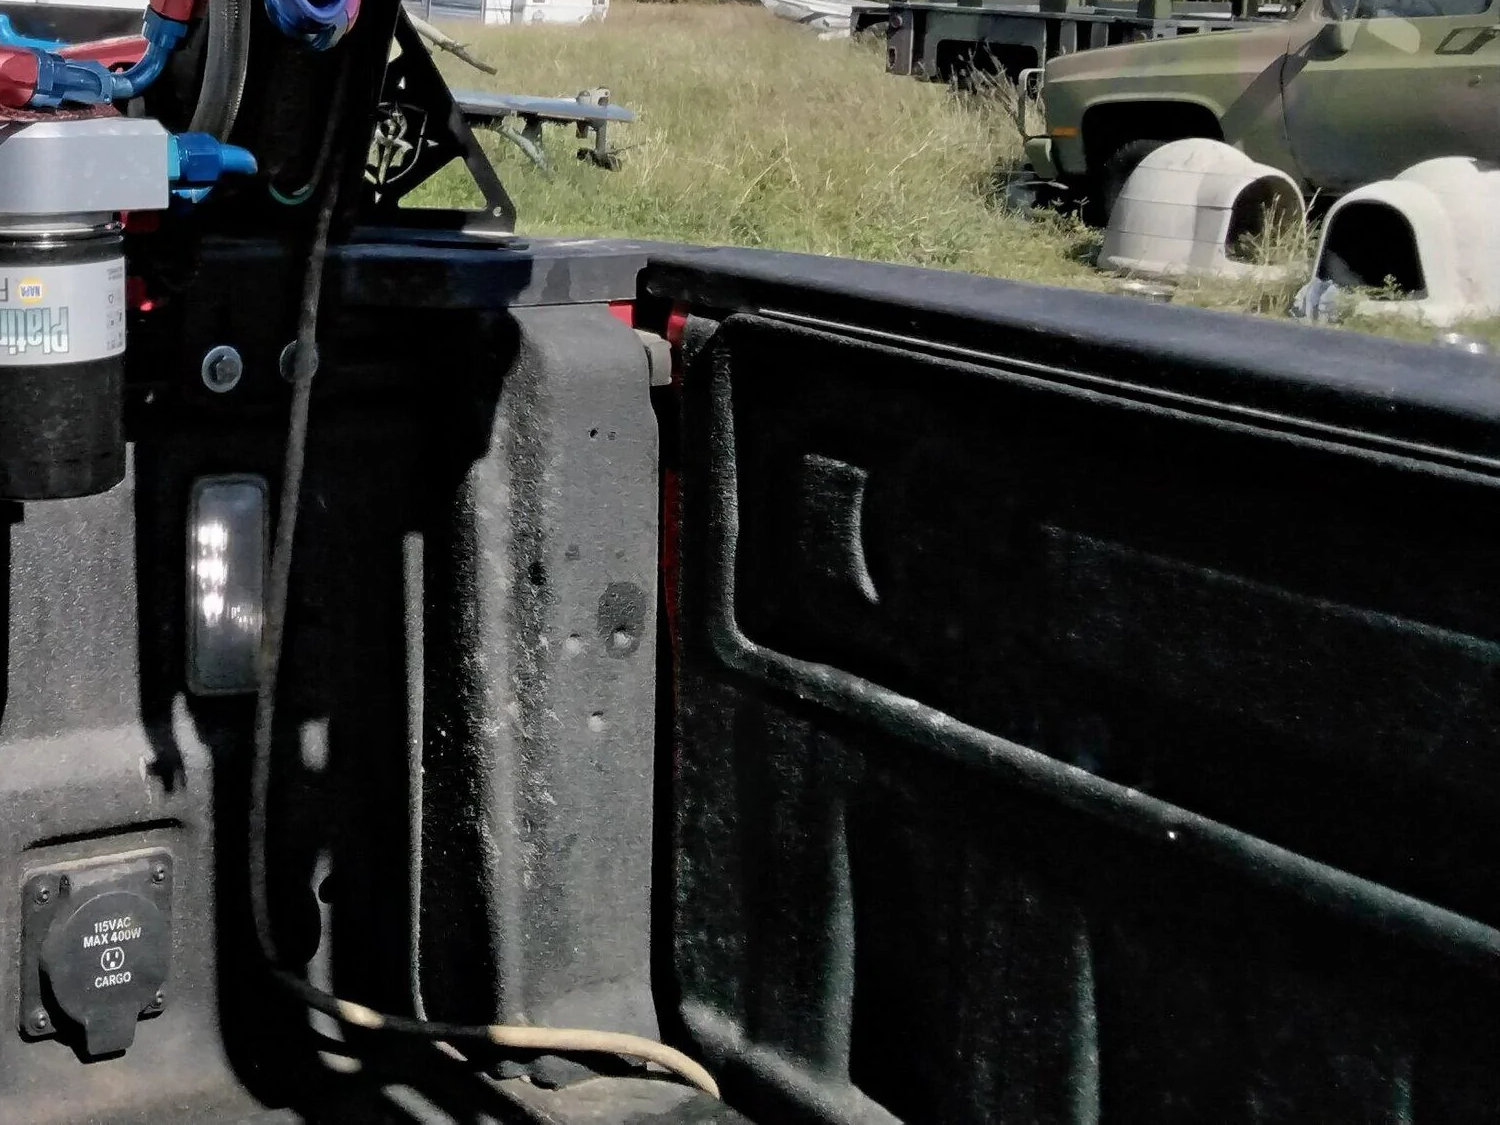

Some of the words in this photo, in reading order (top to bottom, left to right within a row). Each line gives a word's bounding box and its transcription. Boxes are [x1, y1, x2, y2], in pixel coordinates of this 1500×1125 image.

[20, 285, 41, 298] NAPA
[94, 916, 131, 934] 115VAC
[83, 933, 109, 948] MAX
[110, 927, 142, 943] 400W
[94, 971, 131, 988] CARGO
